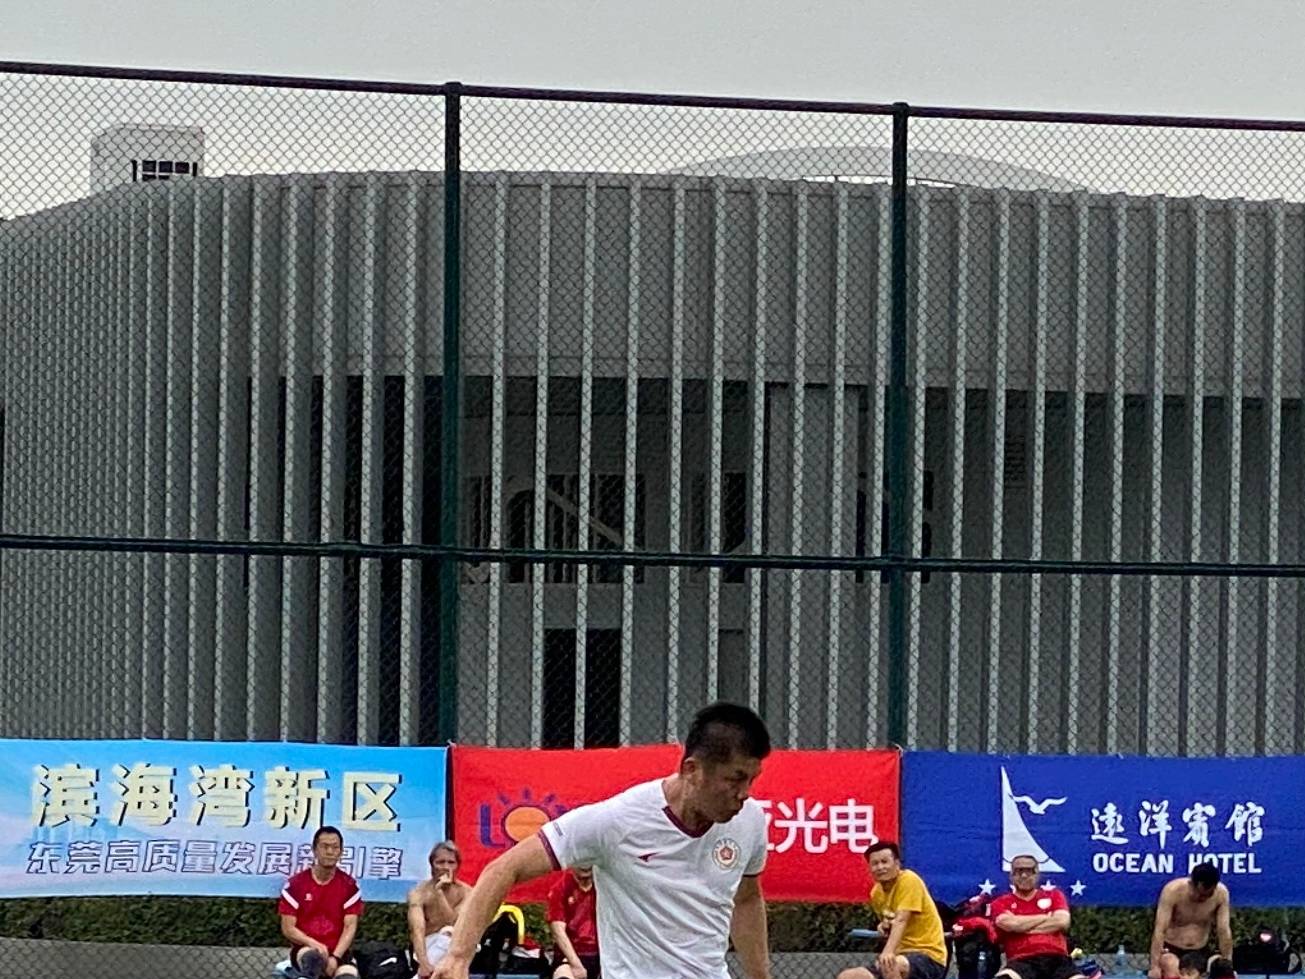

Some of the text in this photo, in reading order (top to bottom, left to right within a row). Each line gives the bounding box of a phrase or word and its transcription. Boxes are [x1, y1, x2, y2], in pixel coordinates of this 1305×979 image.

[31, 763, 402, 831] 滨海湾新区
[1092, 852, 1262, 874] OCEAN HOTEL
